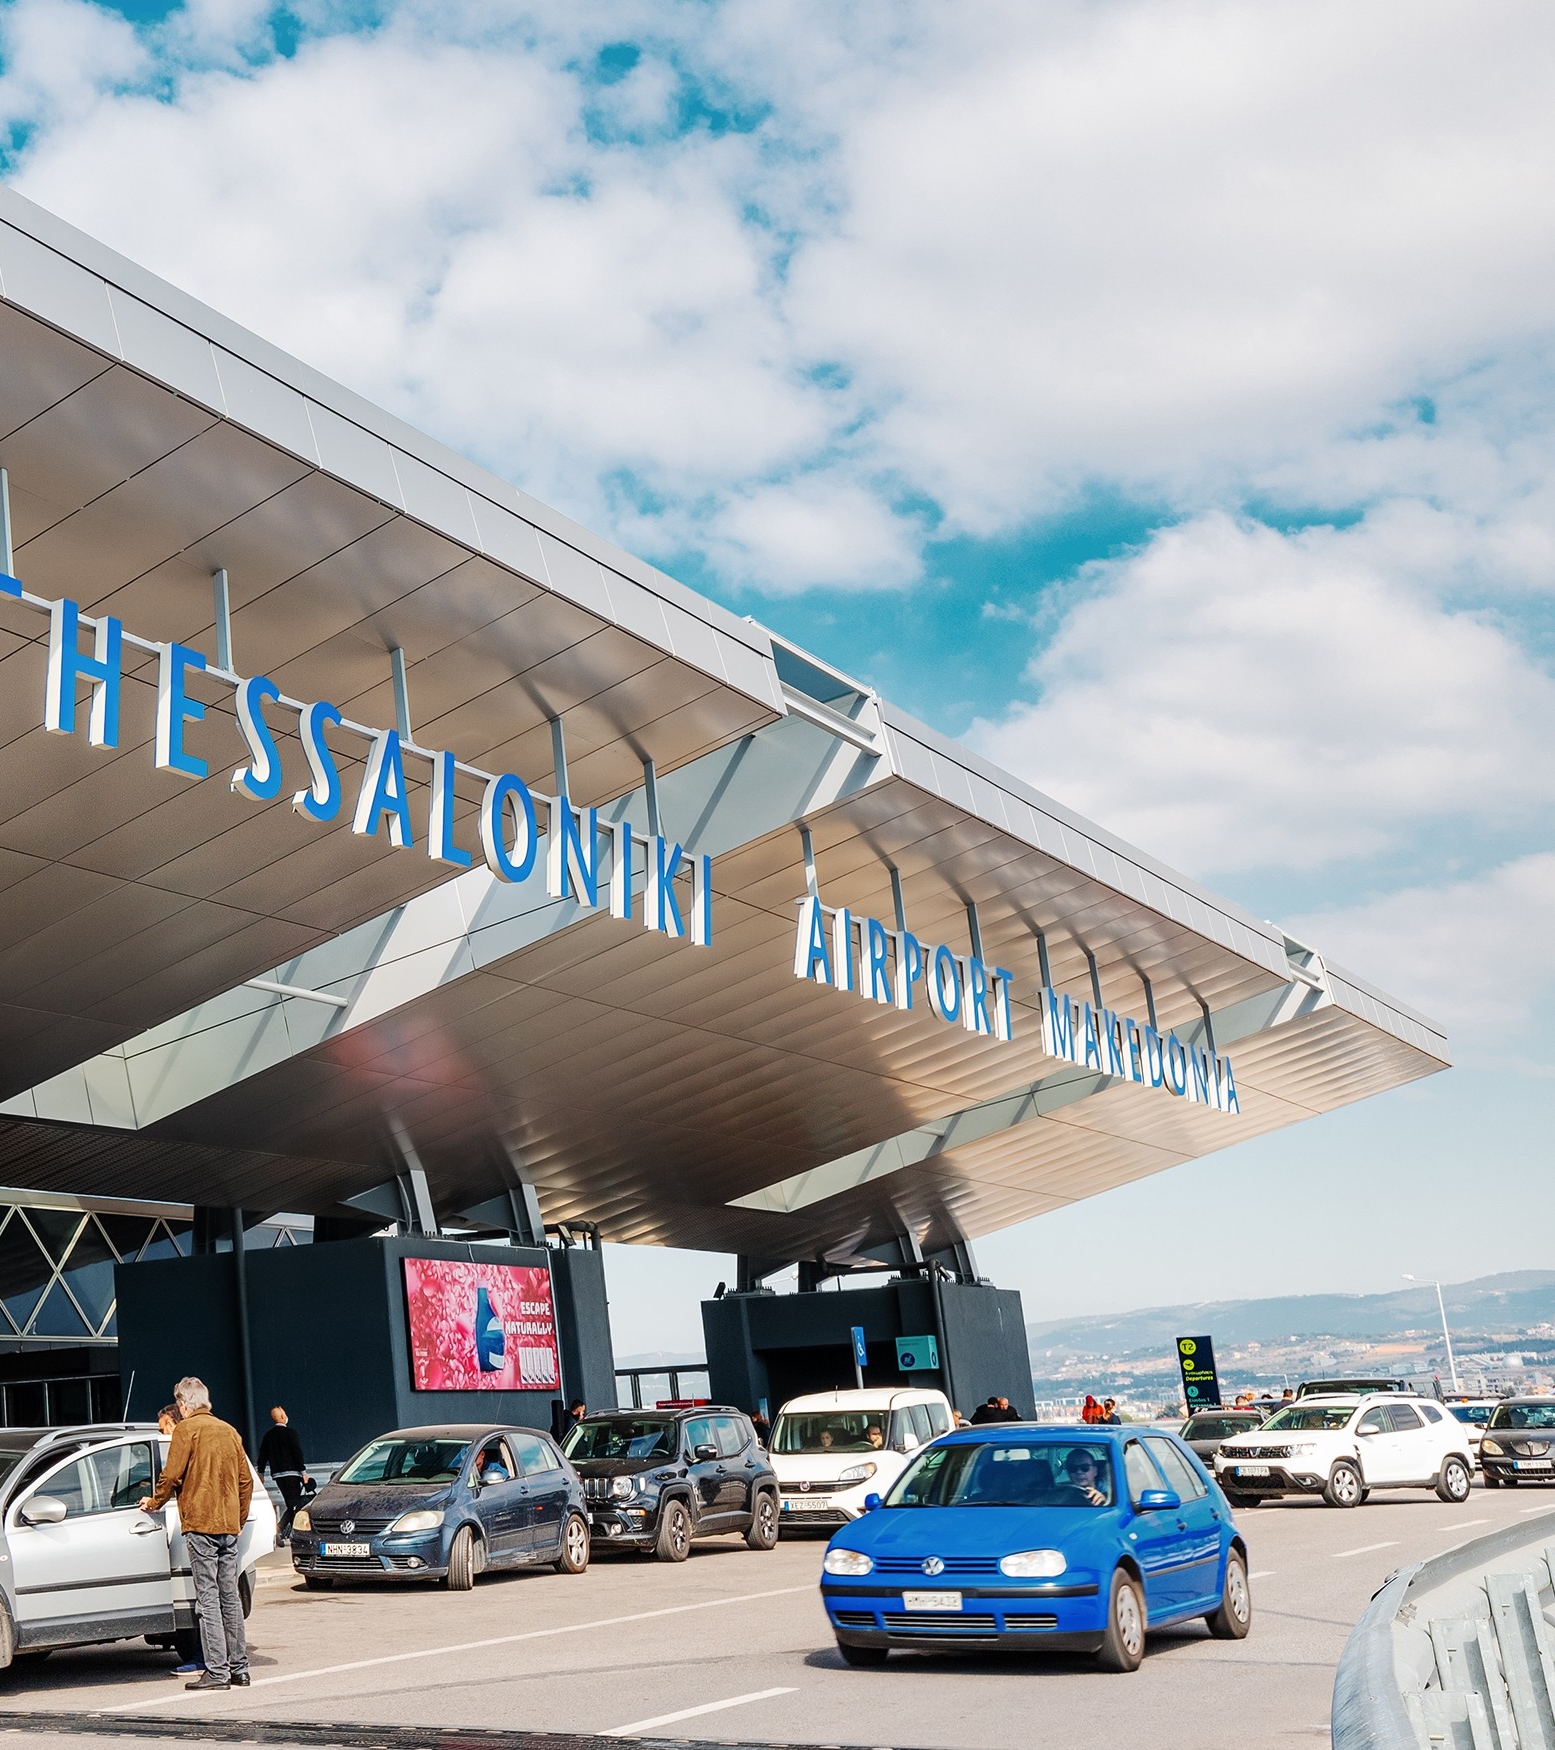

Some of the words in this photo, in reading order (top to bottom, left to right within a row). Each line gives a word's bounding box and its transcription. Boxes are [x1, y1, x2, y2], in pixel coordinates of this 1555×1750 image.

[794, 896, 1014, 1041] AIRPORT
[1039, 986, 1241, 1114] MAKEDONIA
[520, 1302, 551, 1316] ESCAPE
[505, 1321, 553, 1335] NATURALLY
[1182, 1342, 1194, 1351] T2
